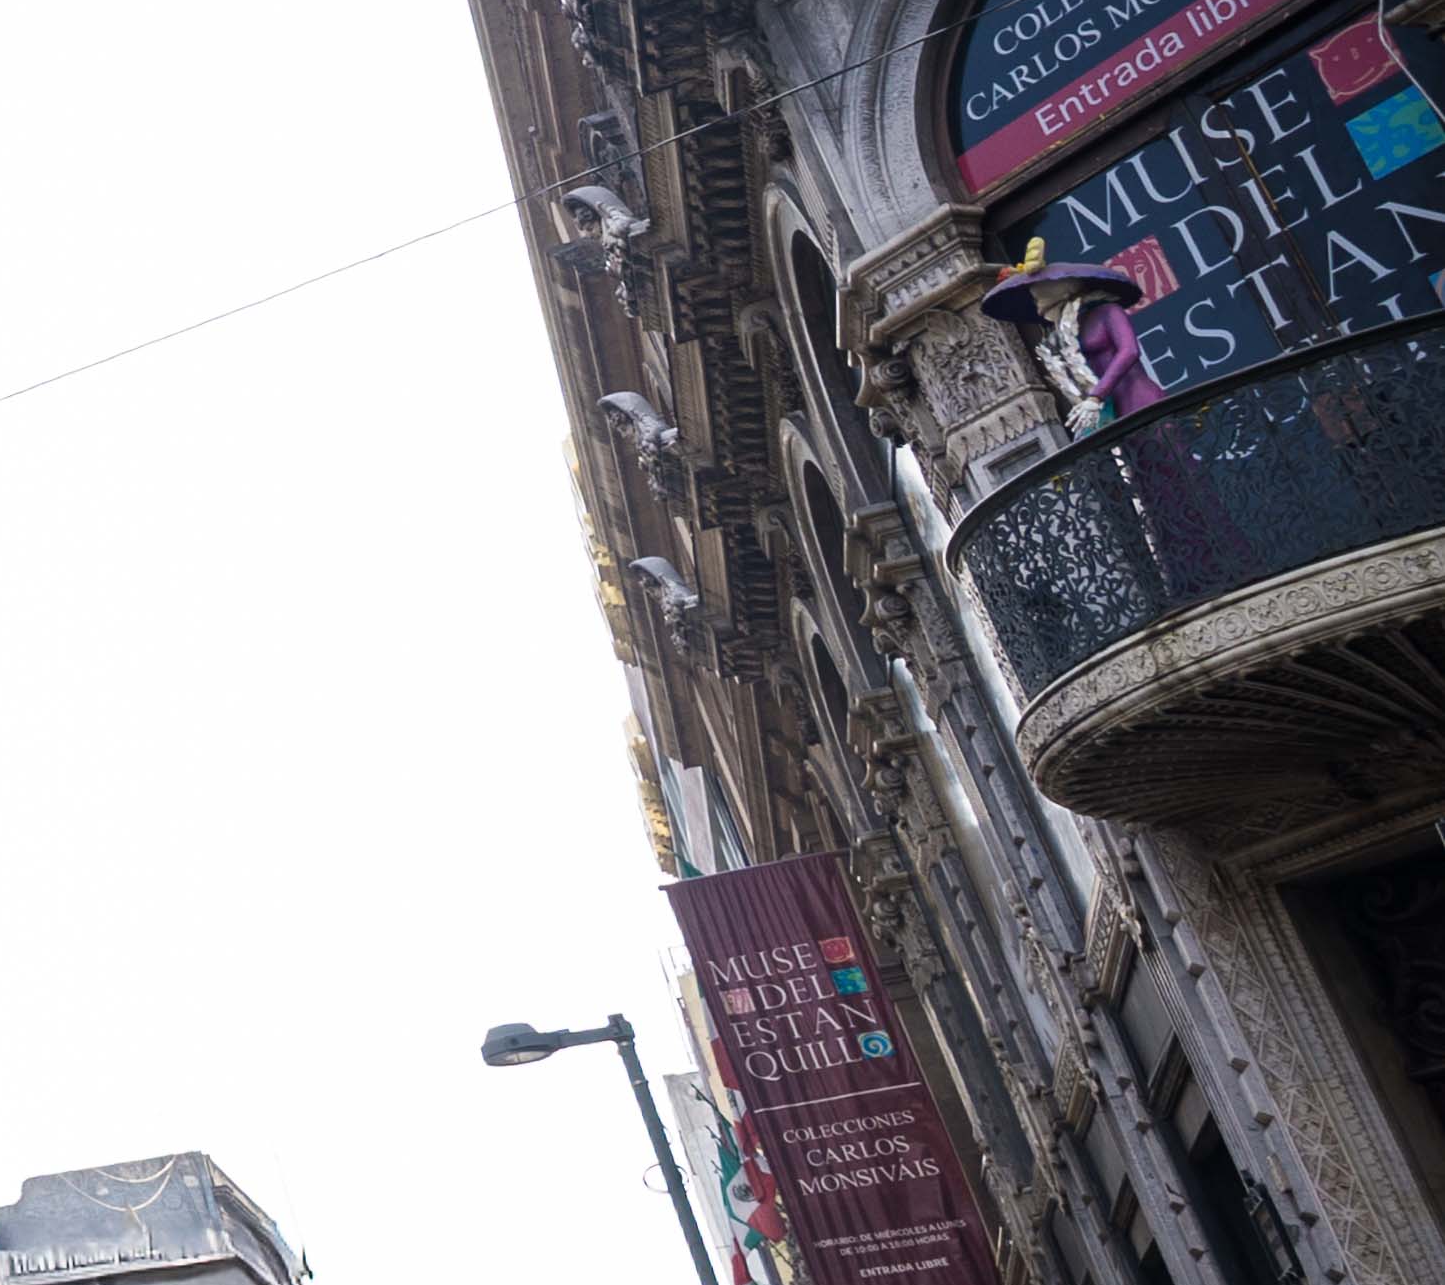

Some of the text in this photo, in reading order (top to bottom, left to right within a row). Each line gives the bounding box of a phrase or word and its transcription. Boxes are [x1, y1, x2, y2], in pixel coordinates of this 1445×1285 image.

[966, 19, 1102, 121] CARLOS
[1034, 30, 1186, 136] Entrada
[1057, 68, 1311, 253] MUSE
[1171, 144, 1363, 278] DEL
[706, 942, 817, 986] MUSE
[755, 974, 835, 1011] DEL
[730, 998, 878, 1049] ESTAN
[745, 1036, 863, 1082] QUILL
[783, 1109, 915, 1144] COLECCIONES
[806, 1135, 911, 1167] CARLOS
[798, 1157, 941, 1196] MONSIVÁIS
[858, 1256, 951, 1278] ENTRADA LIBRE
